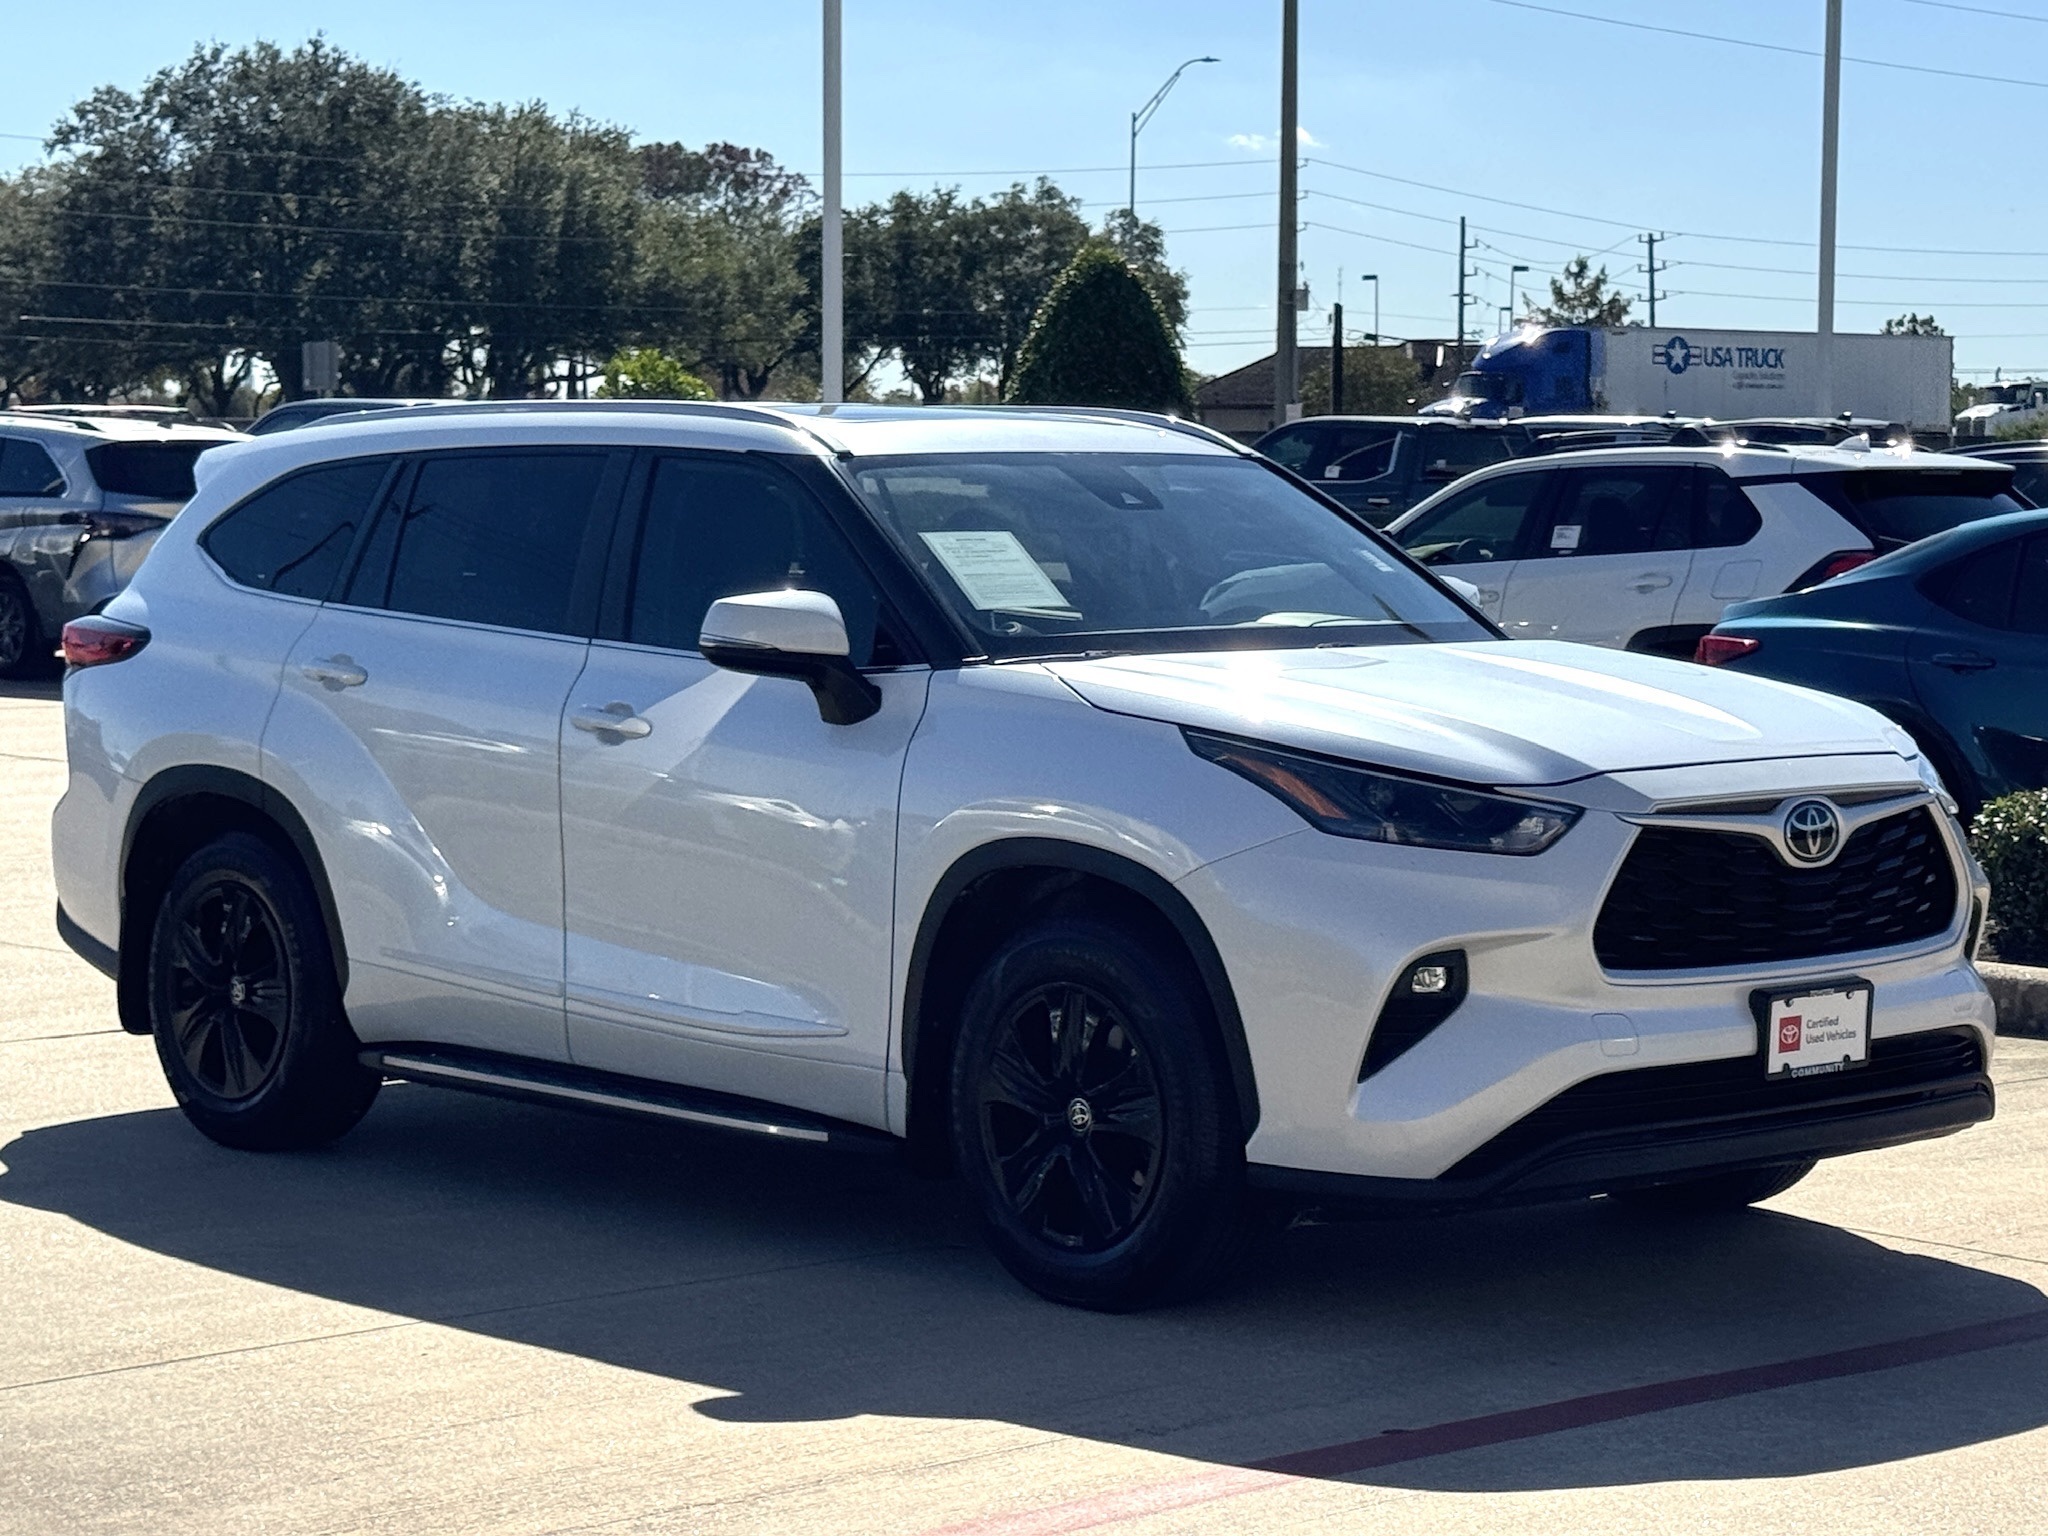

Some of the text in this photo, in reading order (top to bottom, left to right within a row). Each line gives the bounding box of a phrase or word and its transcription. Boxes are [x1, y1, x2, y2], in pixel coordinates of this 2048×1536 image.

[1704, 346, 1785, 369] USA TRUCK
[1806, 1015, 1839, 1029] Certified
[1806, 1028, 1857, 1044] Used Vehicles
[1791, 1062, 1845, 1078] COMMUNITY
